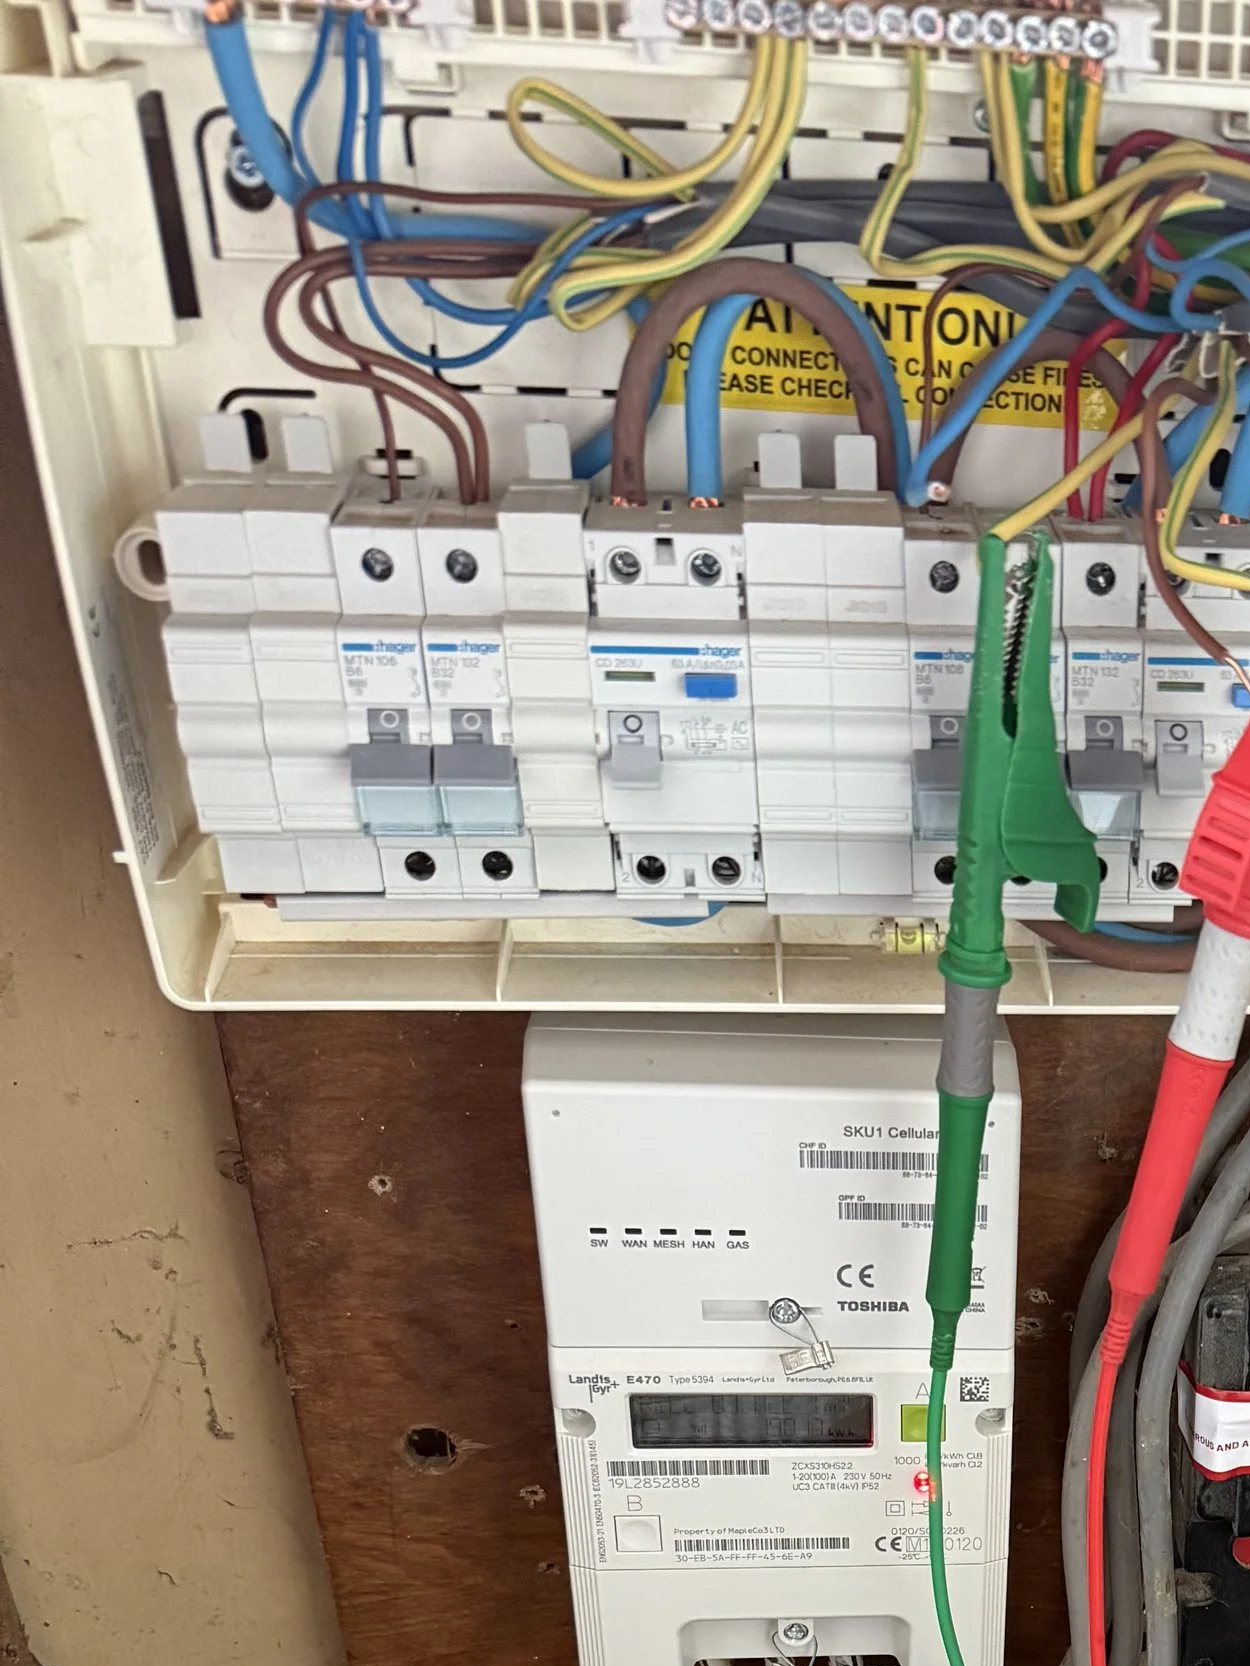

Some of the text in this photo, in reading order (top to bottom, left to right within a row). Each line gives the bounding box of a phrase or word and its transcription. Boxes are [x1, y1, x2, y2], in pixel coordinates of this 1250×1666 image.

[843, 1125, 939, 1139] SKU1 Cellular
[590, 1238, 750, 1251] SW WAN MESH HAN GAS
[837, 1300, 910, 1312] TOSHIBA
[626, 1375, 661, 1385] E470
[669, 1375, 690, 1385] Type
[691, 1375, 715, 1385] 5394
[1216, 1440, 1240, 1453] AND
[894, 1456, 921, 1466] 1000
[608, 1476, 701, 1489] 19L2852888
[792, 1481, 880, 1492] UC3 (4kV) IP52
[626, 1494, 643, 1512] B
[673, 1526, 727, 1536] Property of
[945, 1536, 983, 1551] 0120
